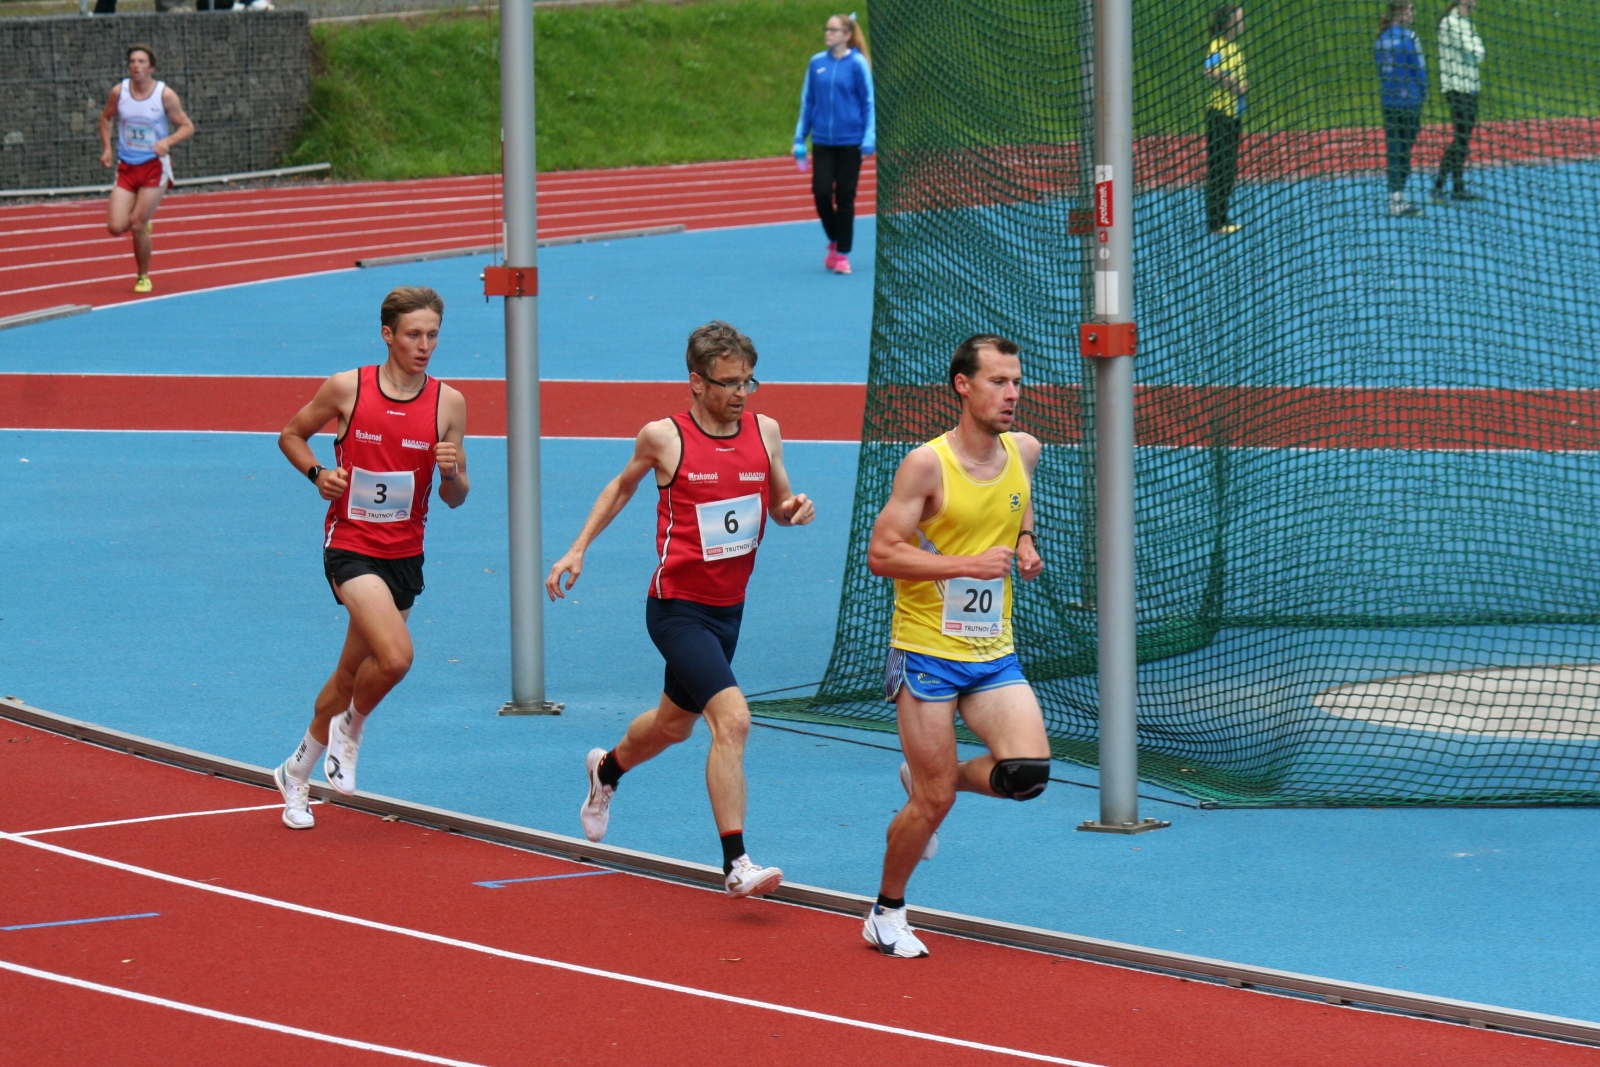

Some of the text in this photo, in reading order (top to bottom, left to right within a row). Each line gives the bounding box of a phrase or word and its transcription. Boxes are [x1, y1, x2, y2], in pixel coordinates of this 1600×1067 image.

[132, 129, 145, 139] 15
[1100, 185, 1109, 224] polanik
[374, 483, 387, 504] 3
[368, 511, 394, 519] TRUTNOV
[724, 510, 739, 534] 6
[725, 542, 750, 553] TRUTNOV
[963, 588, 992, 613] 20
